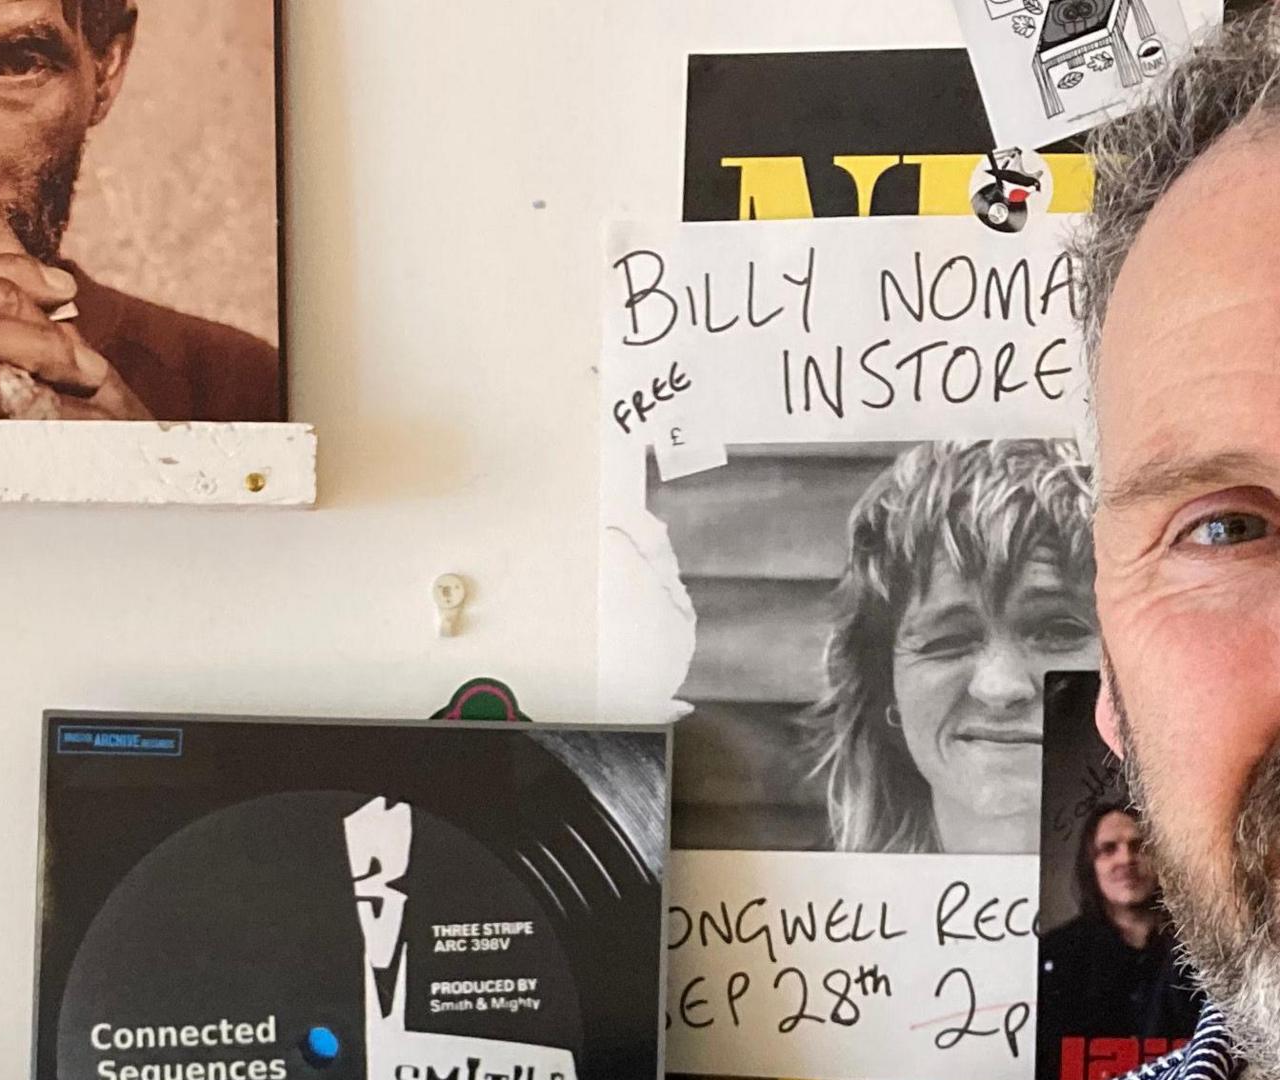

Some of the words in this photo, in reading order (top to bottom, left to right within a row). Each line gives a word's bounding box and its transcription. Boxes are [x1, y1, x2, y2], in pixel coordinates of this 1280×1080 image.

[613, 246, 815, 346] BILLY
[613, 361, 692, 434] FREE
[782, 338, 1074, 418] INSTORE
[431, 923, 481, 938] THREE
[482, 921, 535, 936] STRIPE
[936, 880, 1040, 947] REC
[434, 939, 468, 953] ARC
[470, 937, 511, 951] 398V
[429, 998, 473, 1013] Smith
[475, 996, 489, 1011] &
[490, 996, 541, 1013] Mighty
[430, 978, 516, 996] PRODUCED
[517, 977, 538, 992] BY
[665, 972, 750, 1031] EP
[773, 963, 892, 1034] 28th
[90, 1014, 278, 1050] Connected
